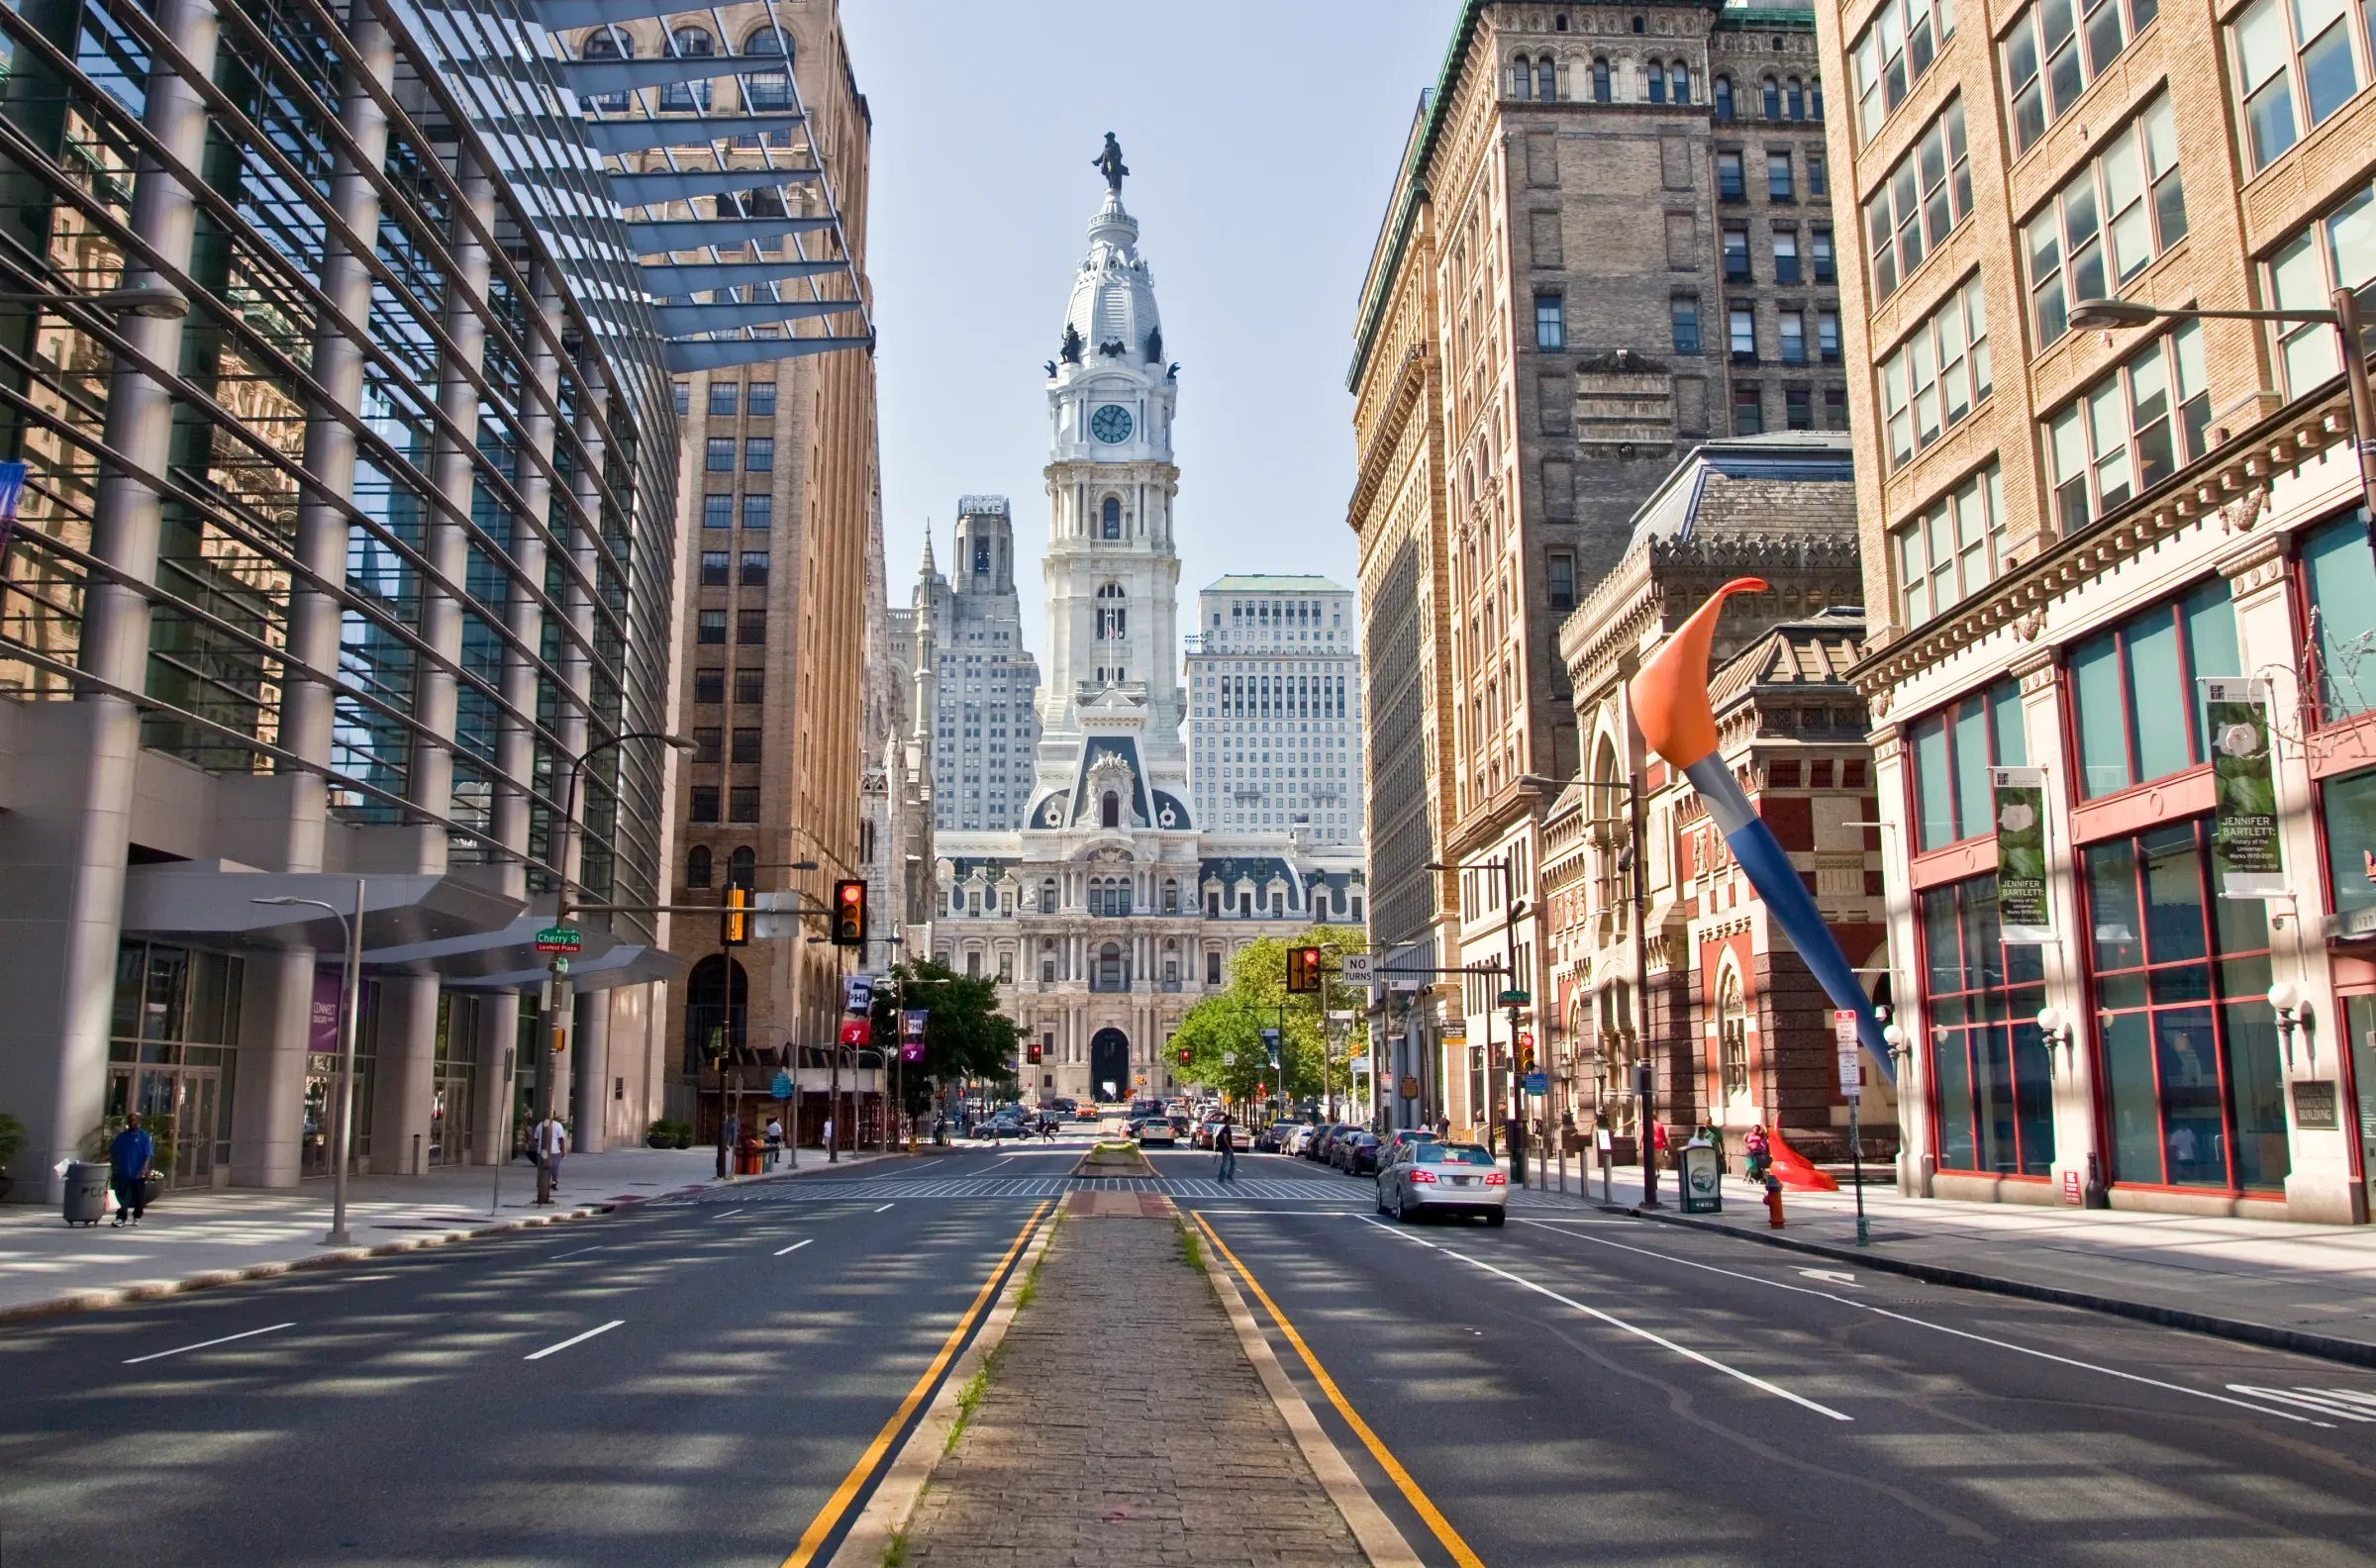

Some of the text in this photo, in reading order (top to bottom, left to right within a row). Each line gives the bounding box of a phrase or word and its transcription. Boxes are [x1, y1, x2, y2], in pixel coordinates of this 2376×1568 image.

[2223, 817, 2270, 826] JENNIFER
[2223, 828, 2276, 836] BARTLETT:
[2002, 888, 2044, 897] BARTLETT:
[538, 933, 580, 945] Cherry St
[1349, 958, 1366, 969] NO
[1344, 972, 1372, 981] TURNS
[313, 1001, 337, 1016] CONNECT
[2297, 1097, 2331, 1109] HAMILTON
[2299, 1109, 2331, 1121] BUILDING
